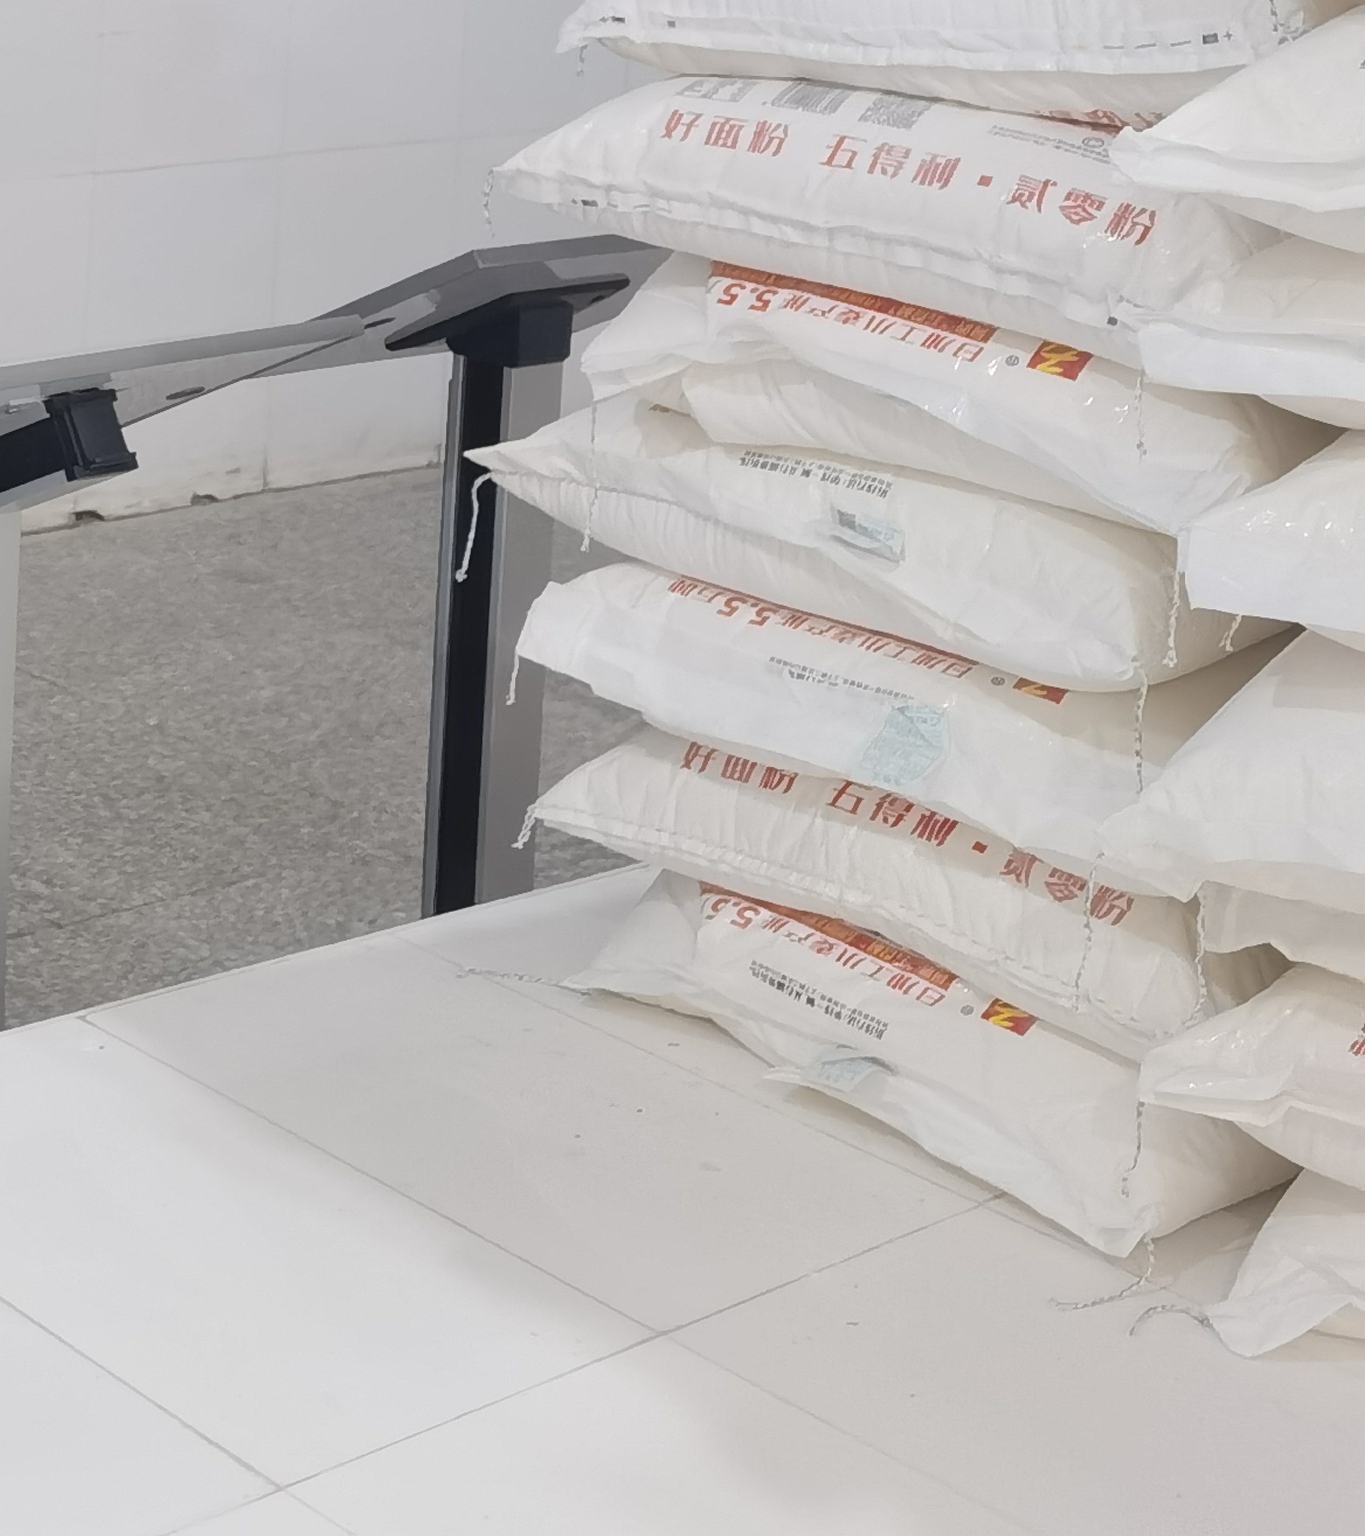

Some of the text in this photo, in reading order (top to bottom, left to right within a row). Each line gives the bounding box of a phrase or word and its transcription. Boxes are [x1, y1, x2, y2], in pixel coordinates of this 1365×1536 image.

[660, 109, 789, 157] 好面粉
[681, 741, 799, 795] 好面粉
